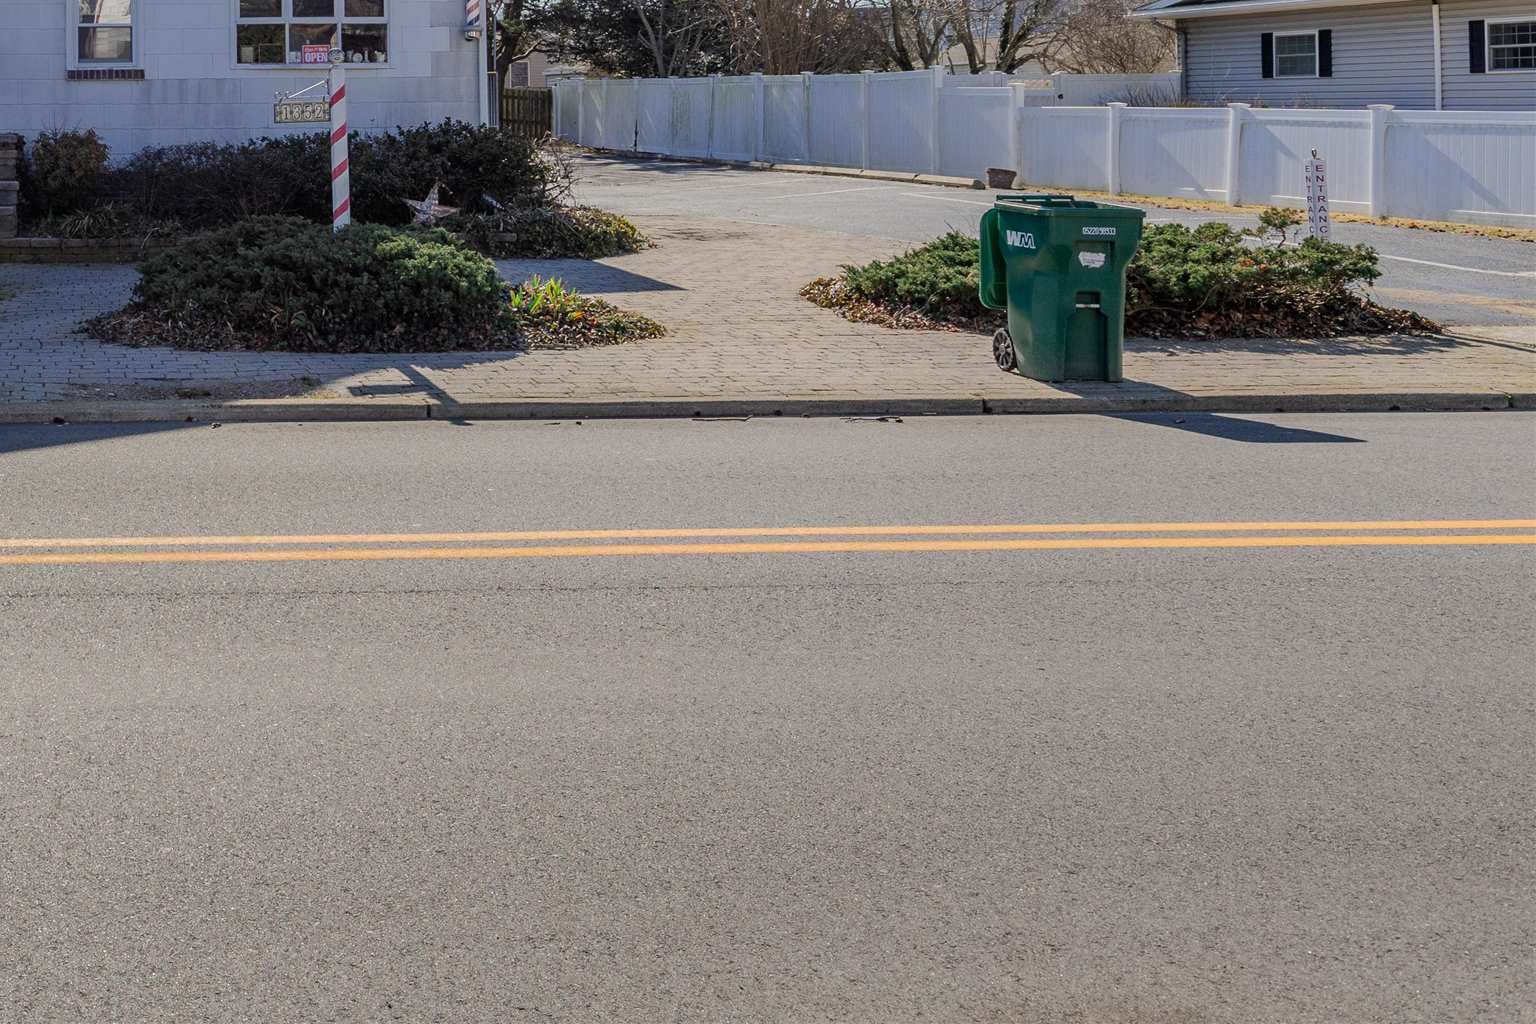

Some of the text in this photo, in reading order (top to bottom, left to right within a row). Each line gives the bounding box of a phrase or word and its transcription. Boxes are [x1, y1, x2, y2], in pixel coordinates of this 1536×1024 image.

[304, 52, 328, 63] OPEN
[1305, 165, 1315, 233] ENTRANC
[1006, 229, 1036, 249] WM
